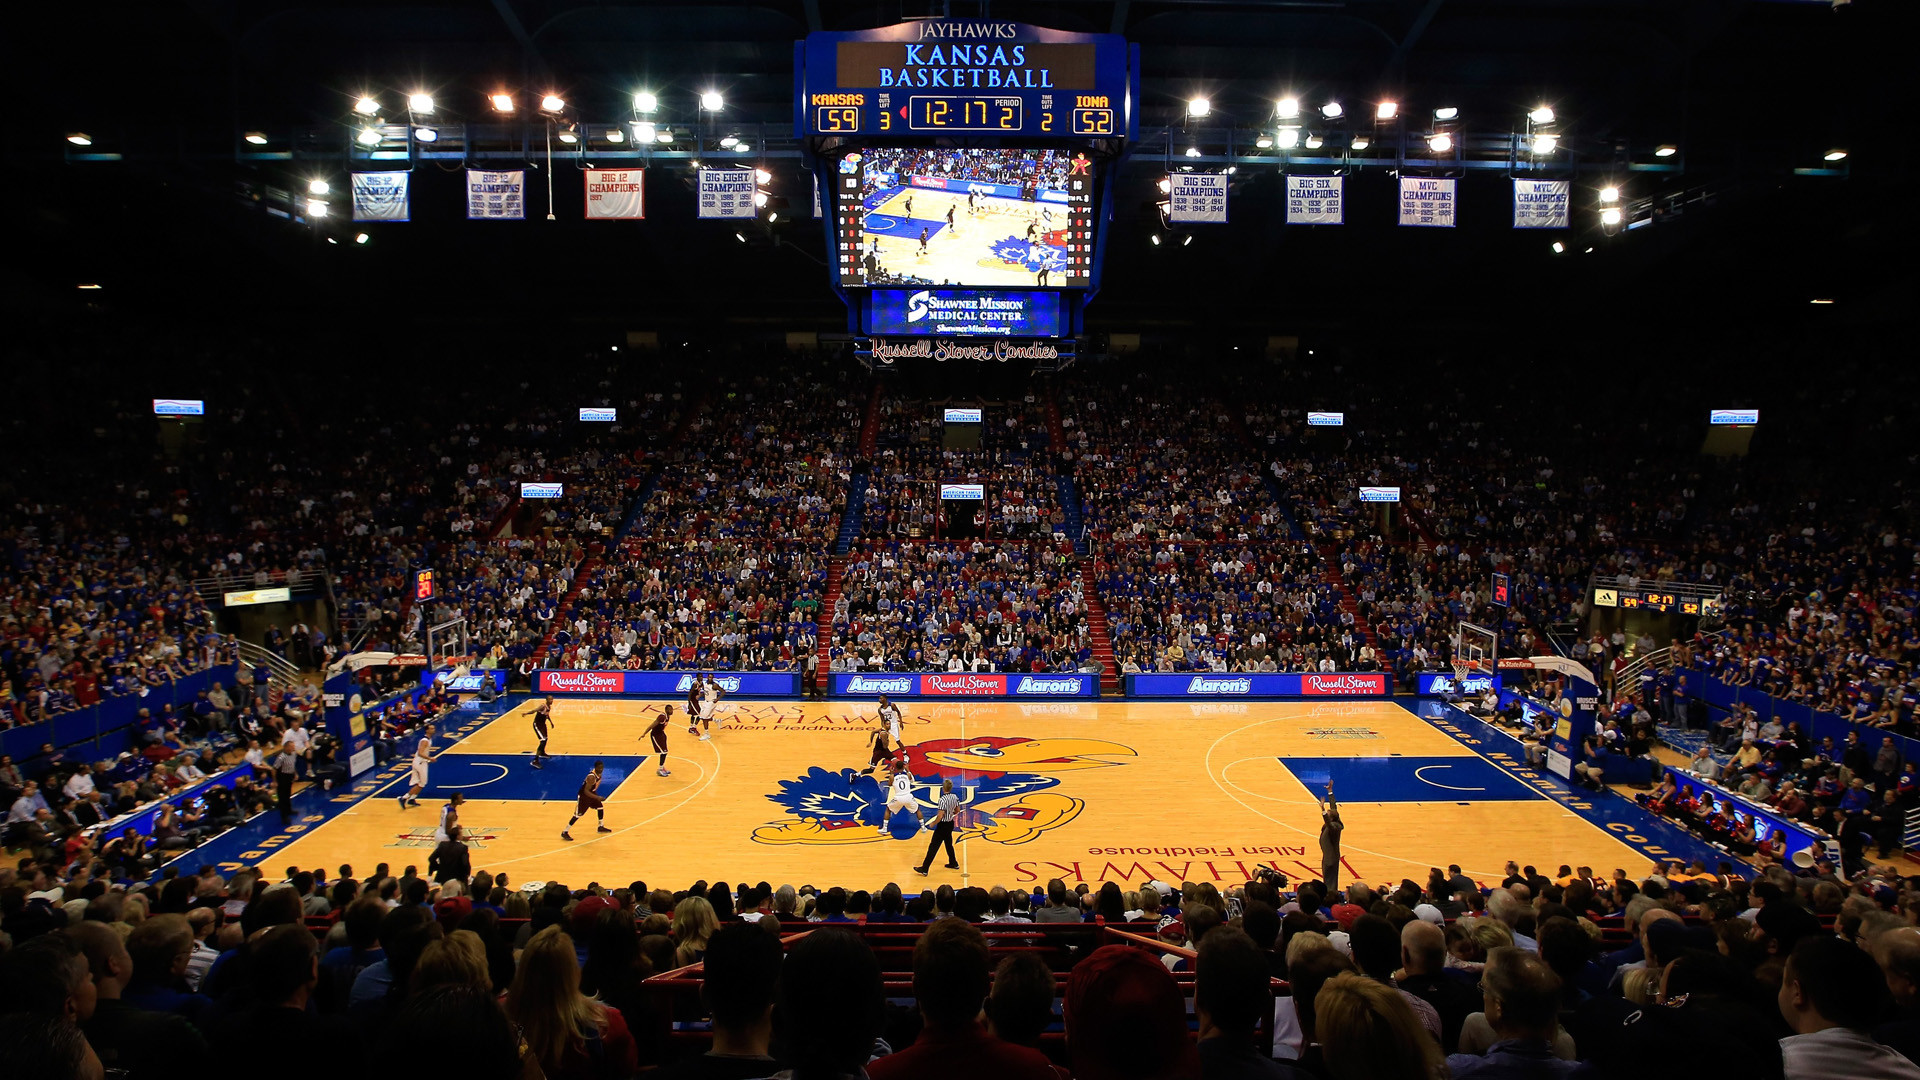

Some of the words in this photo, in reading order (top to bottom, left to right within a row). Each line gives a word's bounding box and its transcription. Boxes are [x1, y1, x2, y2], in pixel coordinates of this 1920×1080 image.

[918, 23, 1016, 40] JAYHAWKS
[905, 44, 1025, 66] KANSAS
[879, 68, 1053, 87] BASKETBALL
[812, 94, 864, 105] KANSAS
[1076, 96, 1109, 107] IONA
[926, 101, 986, 125] 12:17
[1000, 107, 1013, 128] 2
[828, 110, 856, 130] 59
[880, 112, 890, 130] 3
[1041, 113, 1053, 131] 2
[1082, 112, 1109, 132] 52
[483, 174, 497, 182] BIG
[602, 174, 616, 182] BIG
[619, 174, 627, 182] 12
[706, 173, 720, 181] BIG
[723, 173, 749, 182] EIGHT
[1184, 177, 1198, 185] BIG
[1201, 178, 1215, 186] SIX
[471, 184, 519, 193] CHAMPIONS
[590, 184, 639, 192] CHAMPIONS
[702, 183, 752, 192] CHAMPIONS
[1300, 180, 1313, 188] BIG
[1317, 180, 1330, 188] SIX
[1419, 182, 1437, 190] MVC
[1534, 184, 1552, 192] MVC
[1174, 187, 1223, 196] CHAMPIONS
[1291, 189, 1339, 198] CHAMPIONS
[1403, 191, 1451, 200] CHAMPIONS
[1519, 194, 1566, 202] CHAMPIONS
[928, 296, 978, 309] SHAWNEE
[979, 297, 1023, 309] MISSION
[928, 311, 977, 320] MEDICAL
[936, 324, 1010, 335] ShawneeMission.org
[870, 338, 932, 363] Russell
[935, 338, 992, 361] Stover
[994, 338, 1057, 361] Candies
[1624, 598, 1637, 607] 59
[1648, 594, 1673, 604] 12:17
[1684, 603, 1697, 613] 52
[547, 671, 585, 686] Russell
[586, 672, 617, 687] Stover
[847, 676, 912, 693] Aaron's
[928, 675, 966, 690] Russell
[967, 675, 999, 688] Stover
[1017, 676, 1082, 693] Aaron's
[1187, 676, 1251, 693] Aaron's
[1308, 675, 1346, 690] Russell
[1346, 675, 1377, 688] Stover
[780, 724, 877, 732] Fieldhouse
[1425, 714, 1482, 745] James
[1486, 752, 1592, 810] Naismith
[898, 781, 906, 791] 0
[217, 813, 325, 872] James
[442, 712, 498, 739] Court
[1088, 846, 1235, 857] Fieldhouse
[1242, 846, 1306, 857] Allen
